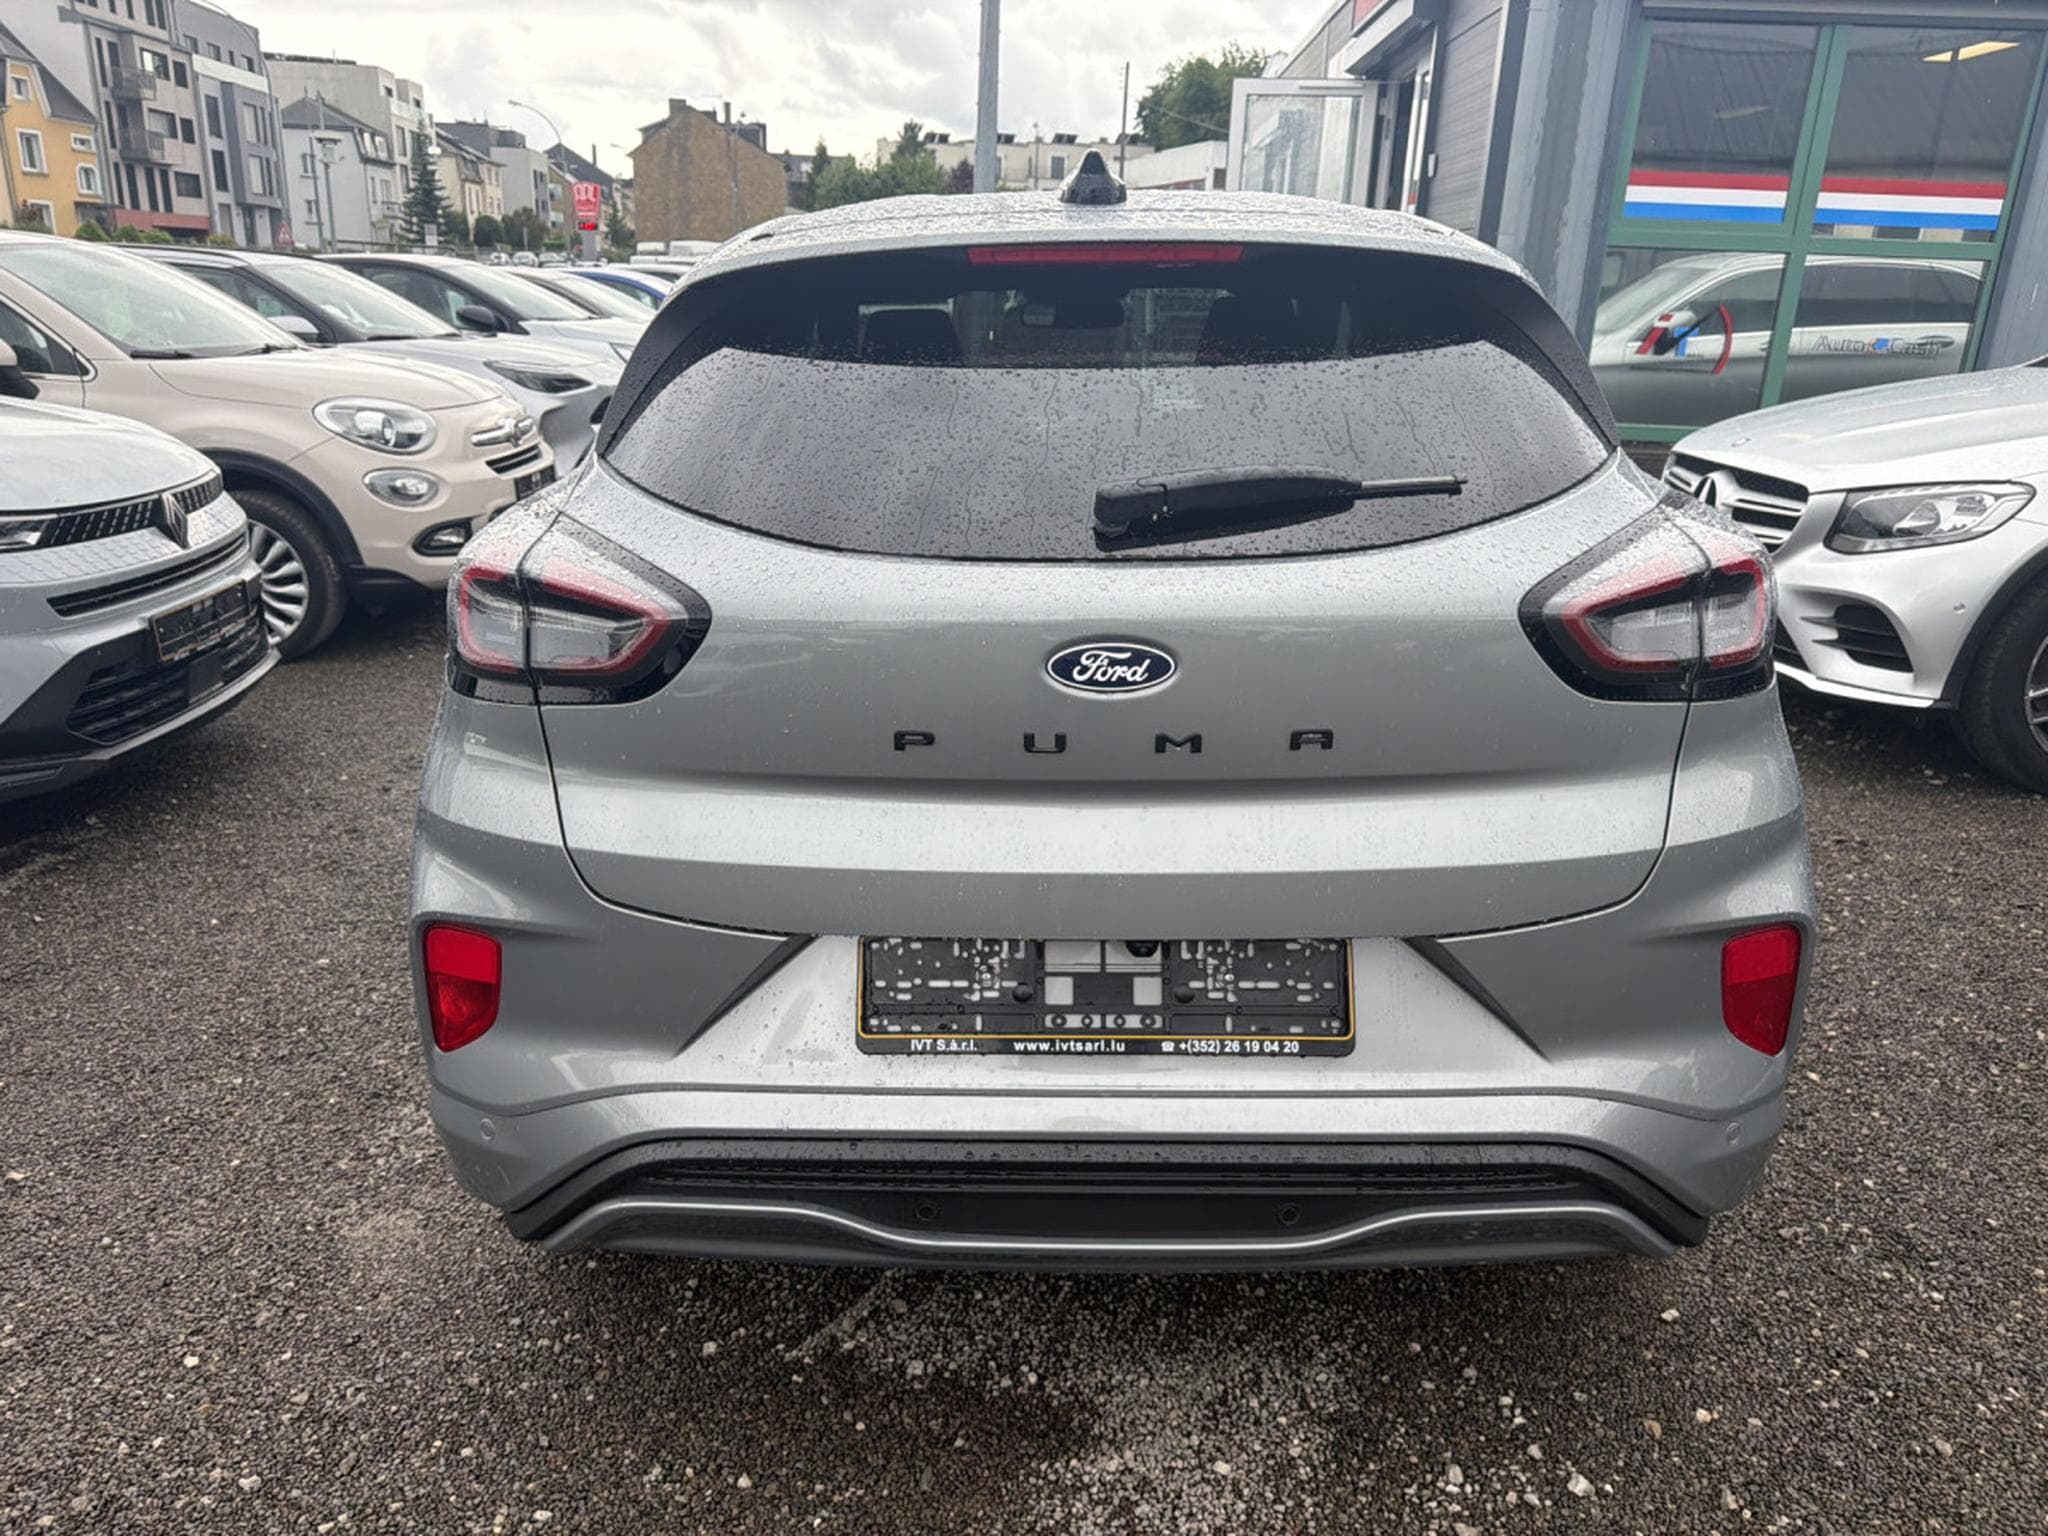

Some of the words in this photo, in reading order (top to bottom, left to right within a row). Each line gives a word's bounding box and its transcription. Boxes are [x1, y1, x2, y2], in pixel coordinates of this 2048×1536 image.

[1072, 649, 1150, 684] Ford
[893, 729, 1334, 754] PUMA
[910, 1039, 933, 1051] IVT
[1013, 1039, 1125, 1052] www.ivtsarl.lu
[1179, 1040, 1220, 1054] +(352)
[1224, 1041, 1240, 1053] 26
[1244, 1041, 1260, 1053] 19
[1263, 1041, 1280, 1053] 04
[1283, 1041, 1300, 1053] 20
